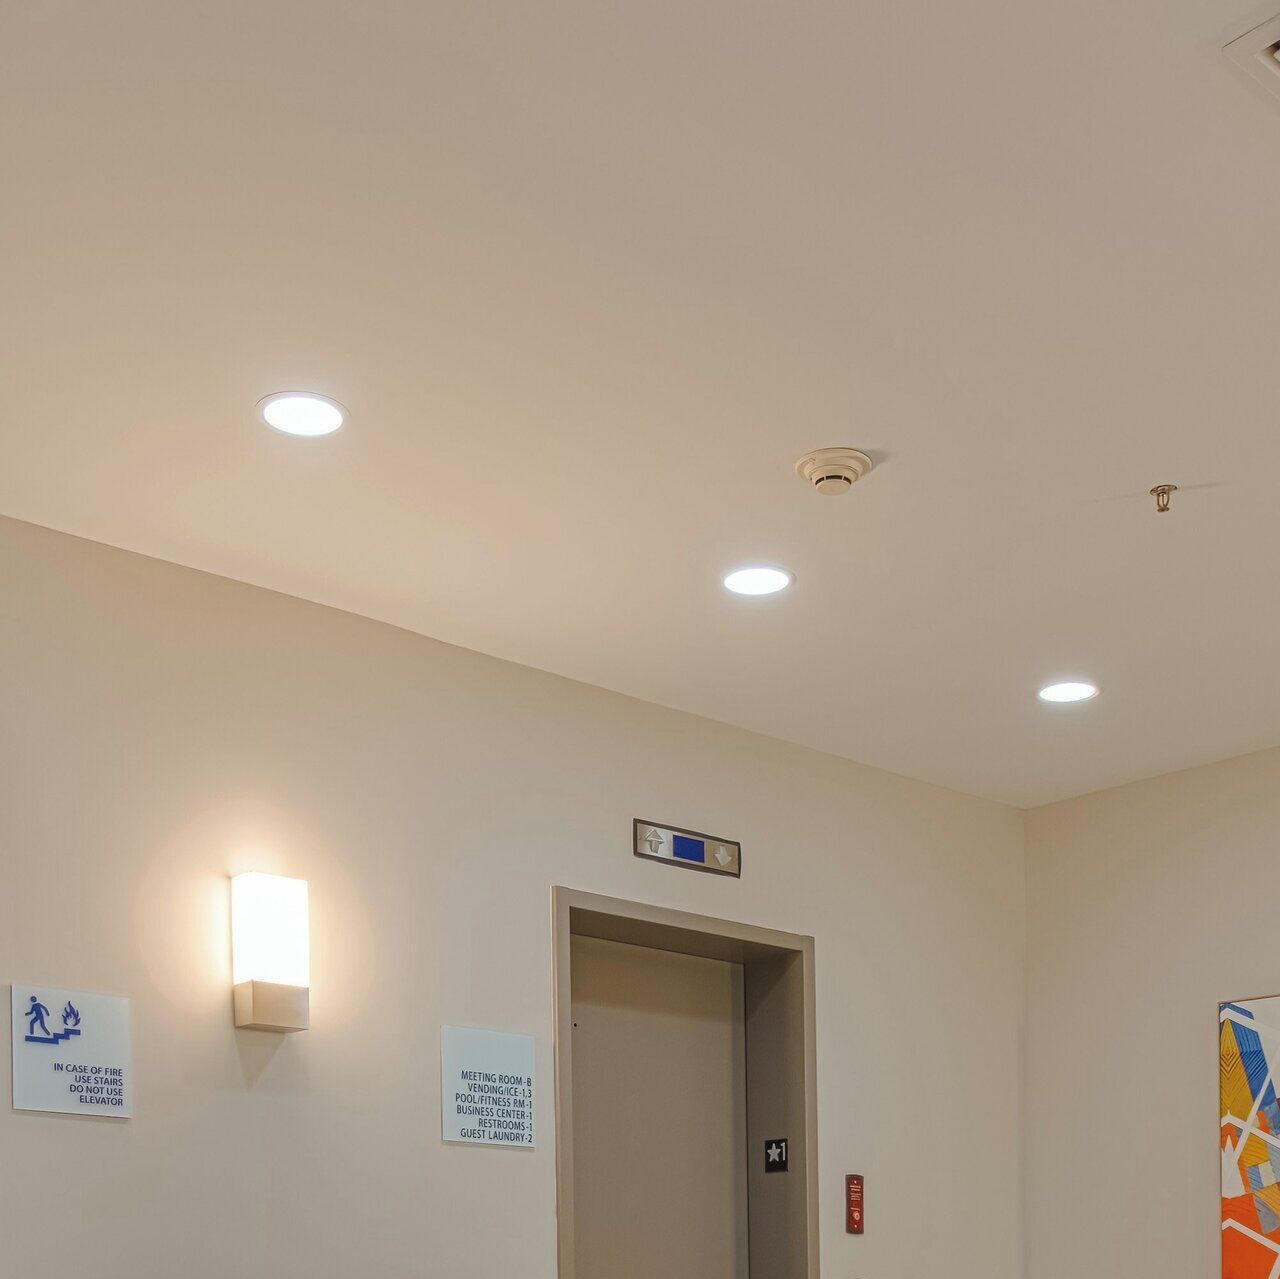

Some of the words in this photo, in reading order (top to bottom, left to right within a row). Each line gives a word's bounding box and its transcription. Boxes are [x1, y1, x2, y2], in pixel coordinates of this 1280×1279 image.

[53, 1062, 63, 1072] IN
[66, 1064, 89, 1074] CASE
[90, 1066, 102, 1075] OF
[105, 1068, 123, 1077] FIRE
[74, 1075, 91, 1084] USE
[94, 1076, 124, 1087] STAIRS
[461, 1070, 496, 1083] MEETING
[69, 1084, 84, 1093] DO
[86, 1086, 104, 1095] NOT
[106, 1087, 123, 1096] USE
[79, 1095, 123, 1106] ELEVATOR
[455, 1093, 511, 1107] POOL/FITNESS
[456, 1104, 494, 1117] BUSINESS
[460, 1128, 486, 1139] GUEST
[780, 1142, 786, 1161] 1
